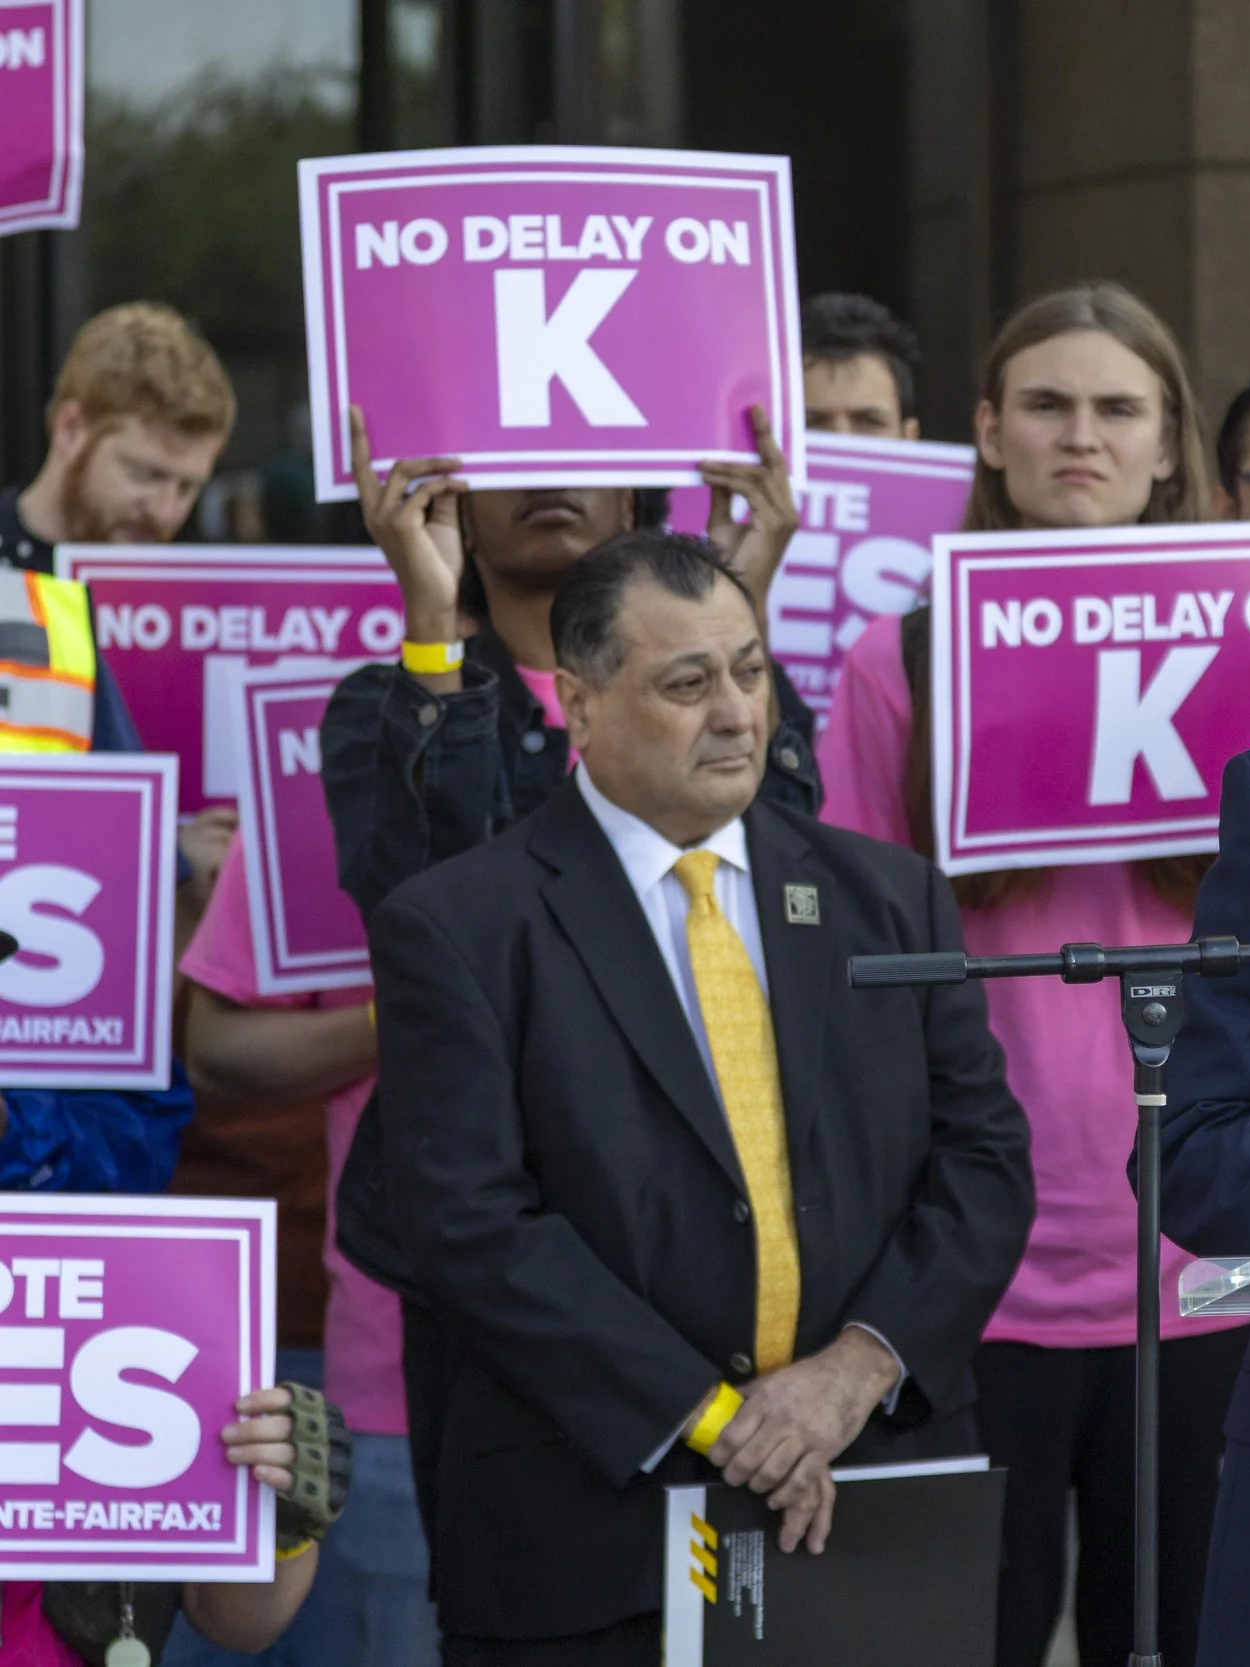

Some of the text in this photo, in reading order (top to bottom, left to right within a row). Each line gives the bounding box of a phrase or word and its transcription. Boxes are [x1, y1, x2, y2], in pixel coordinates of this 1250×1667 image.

[0, 28, 45, 69] N
[355, 214, 751, 269] NO DELAY ON
[494, 268, 648, 428] K
[795, 481, 870, 532] TE
[97, 604, 405, 651] NO DELAY O
[981, 599, 1063, 648] NO
[1074, 592, 1233, 644] DELAY
[1089, 645, 1220, 806] K
[0, 1015, 124, 1044] AIRFAX!
[0, 1258, 104, 1320] TE
[0, 1325, 201, 1489] ES
